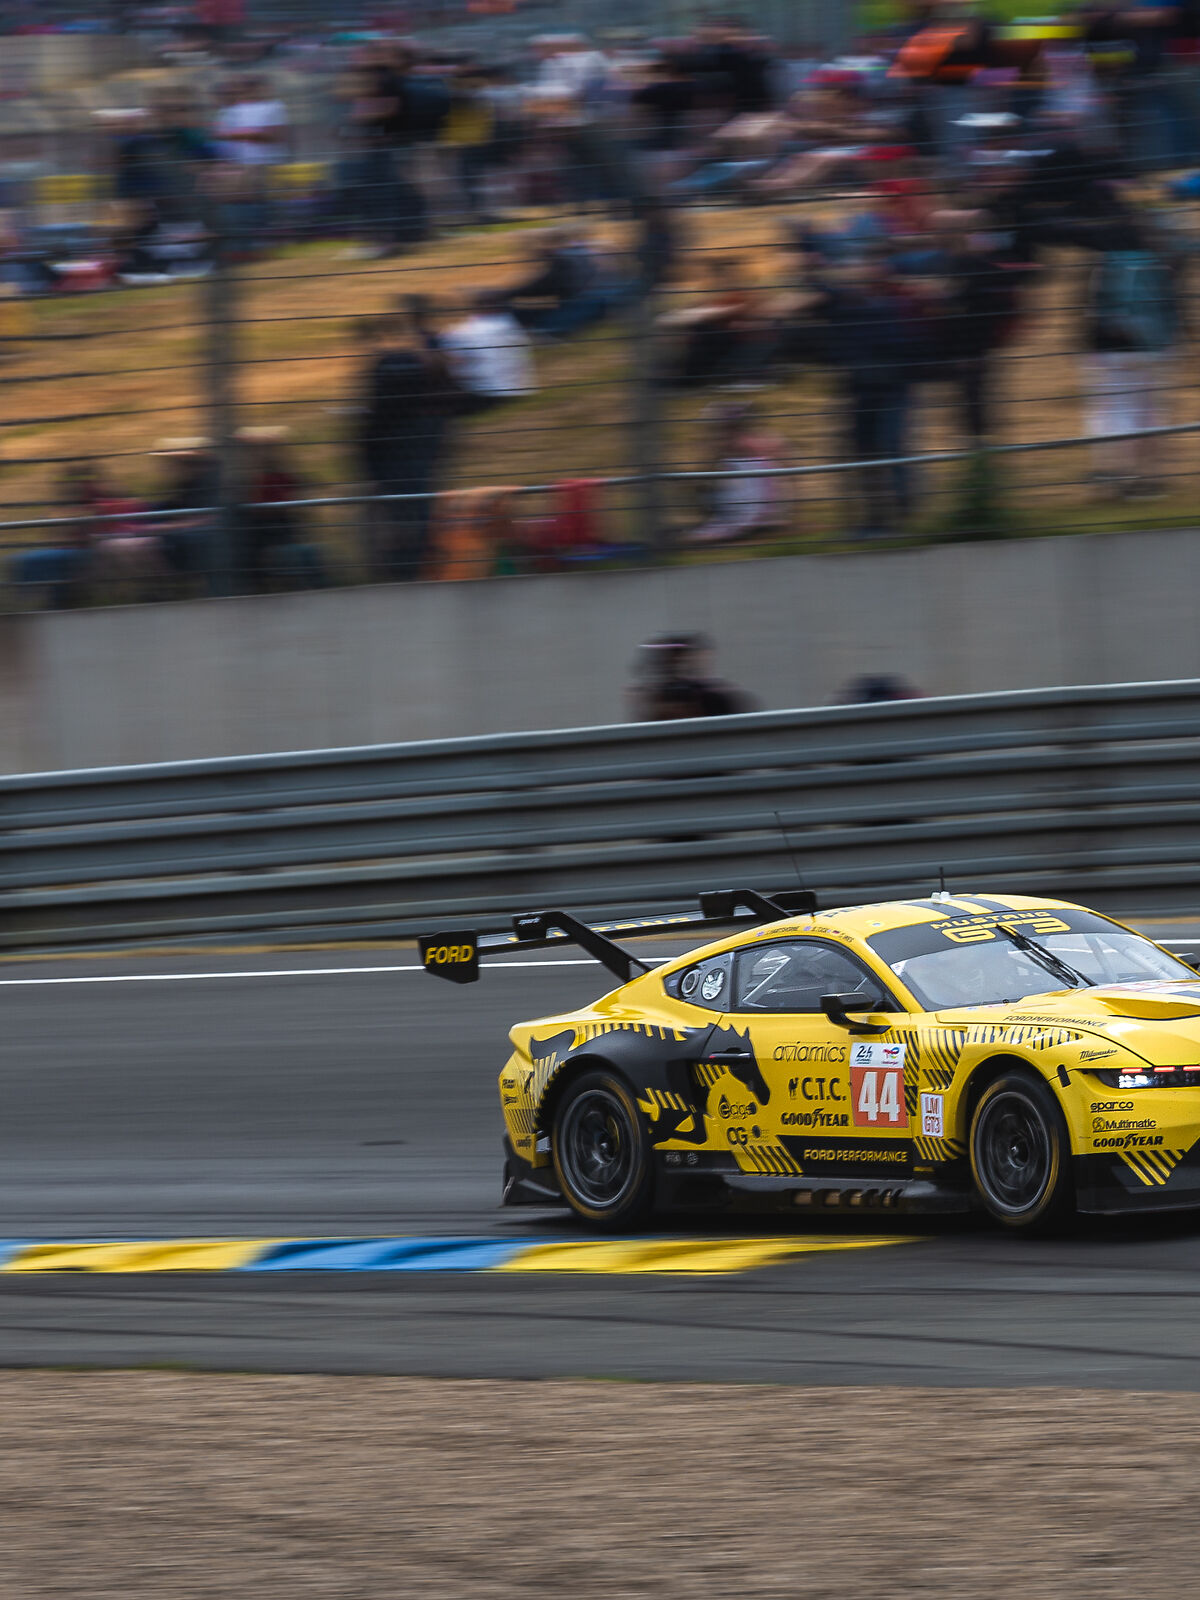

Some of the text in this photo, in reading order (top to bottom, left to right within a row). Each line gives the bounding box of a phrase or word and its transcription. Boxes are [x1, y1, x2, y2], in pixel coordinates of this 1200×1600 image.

[930, 911, 1052, 930] MUSTANG
[941, 917, 1072, 943] GT3
[425, 945, 474, 965] FORD
[801, 1077, 847, 1101] C.T.C.
[858, 1071, 900, 1122] 44
[1090, 1101, 1134, 1112] sparco
[780, 1108, 849, 1129] GOODYEAR
[924, 1115, 941, 1134] GT3
[1105, 1118, 1157, 1130] Multimatic
[1093, 1133, 1164, 1149] GOODYEAR
[803, 1149, 909, 1163] FORD PERFORMANCE
